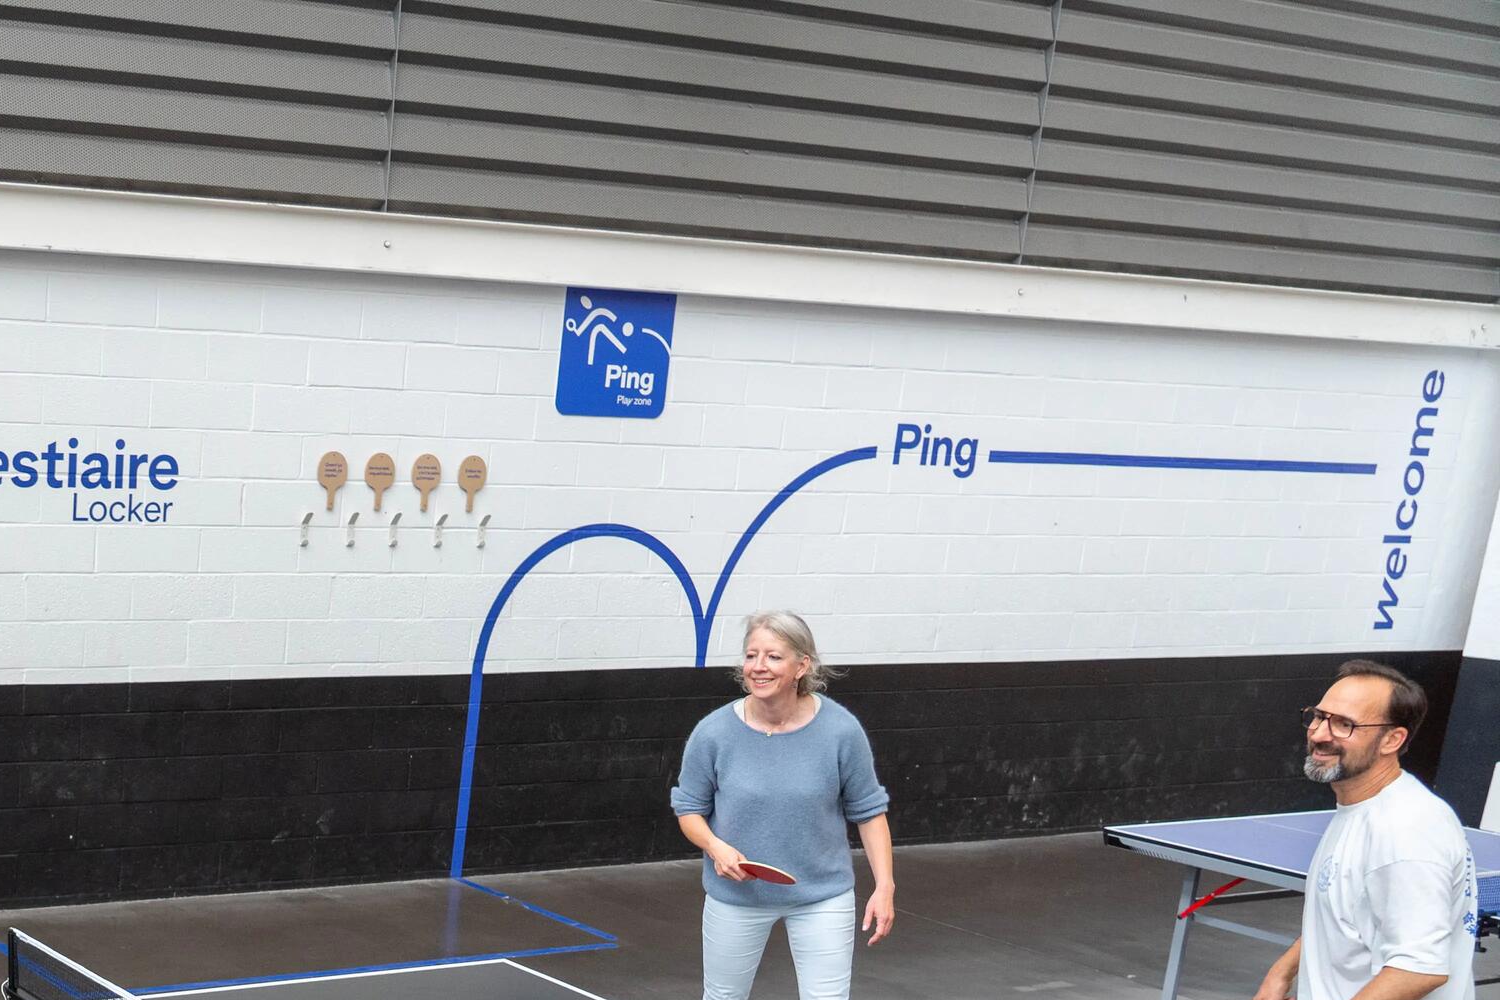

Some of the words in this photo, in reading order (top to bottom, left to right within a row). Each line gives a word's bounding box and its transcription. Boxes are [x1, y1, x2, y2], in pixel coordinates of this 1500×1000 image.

[604, 364, 655, 396] Ping
[616, 394, 633, 407] Play
[633, 397, 652, 406] zone
[892, 423, 979, 479] Ping
[72, 492, 173, 523] Locker
[1373, 369, 1446, 630] welcome
